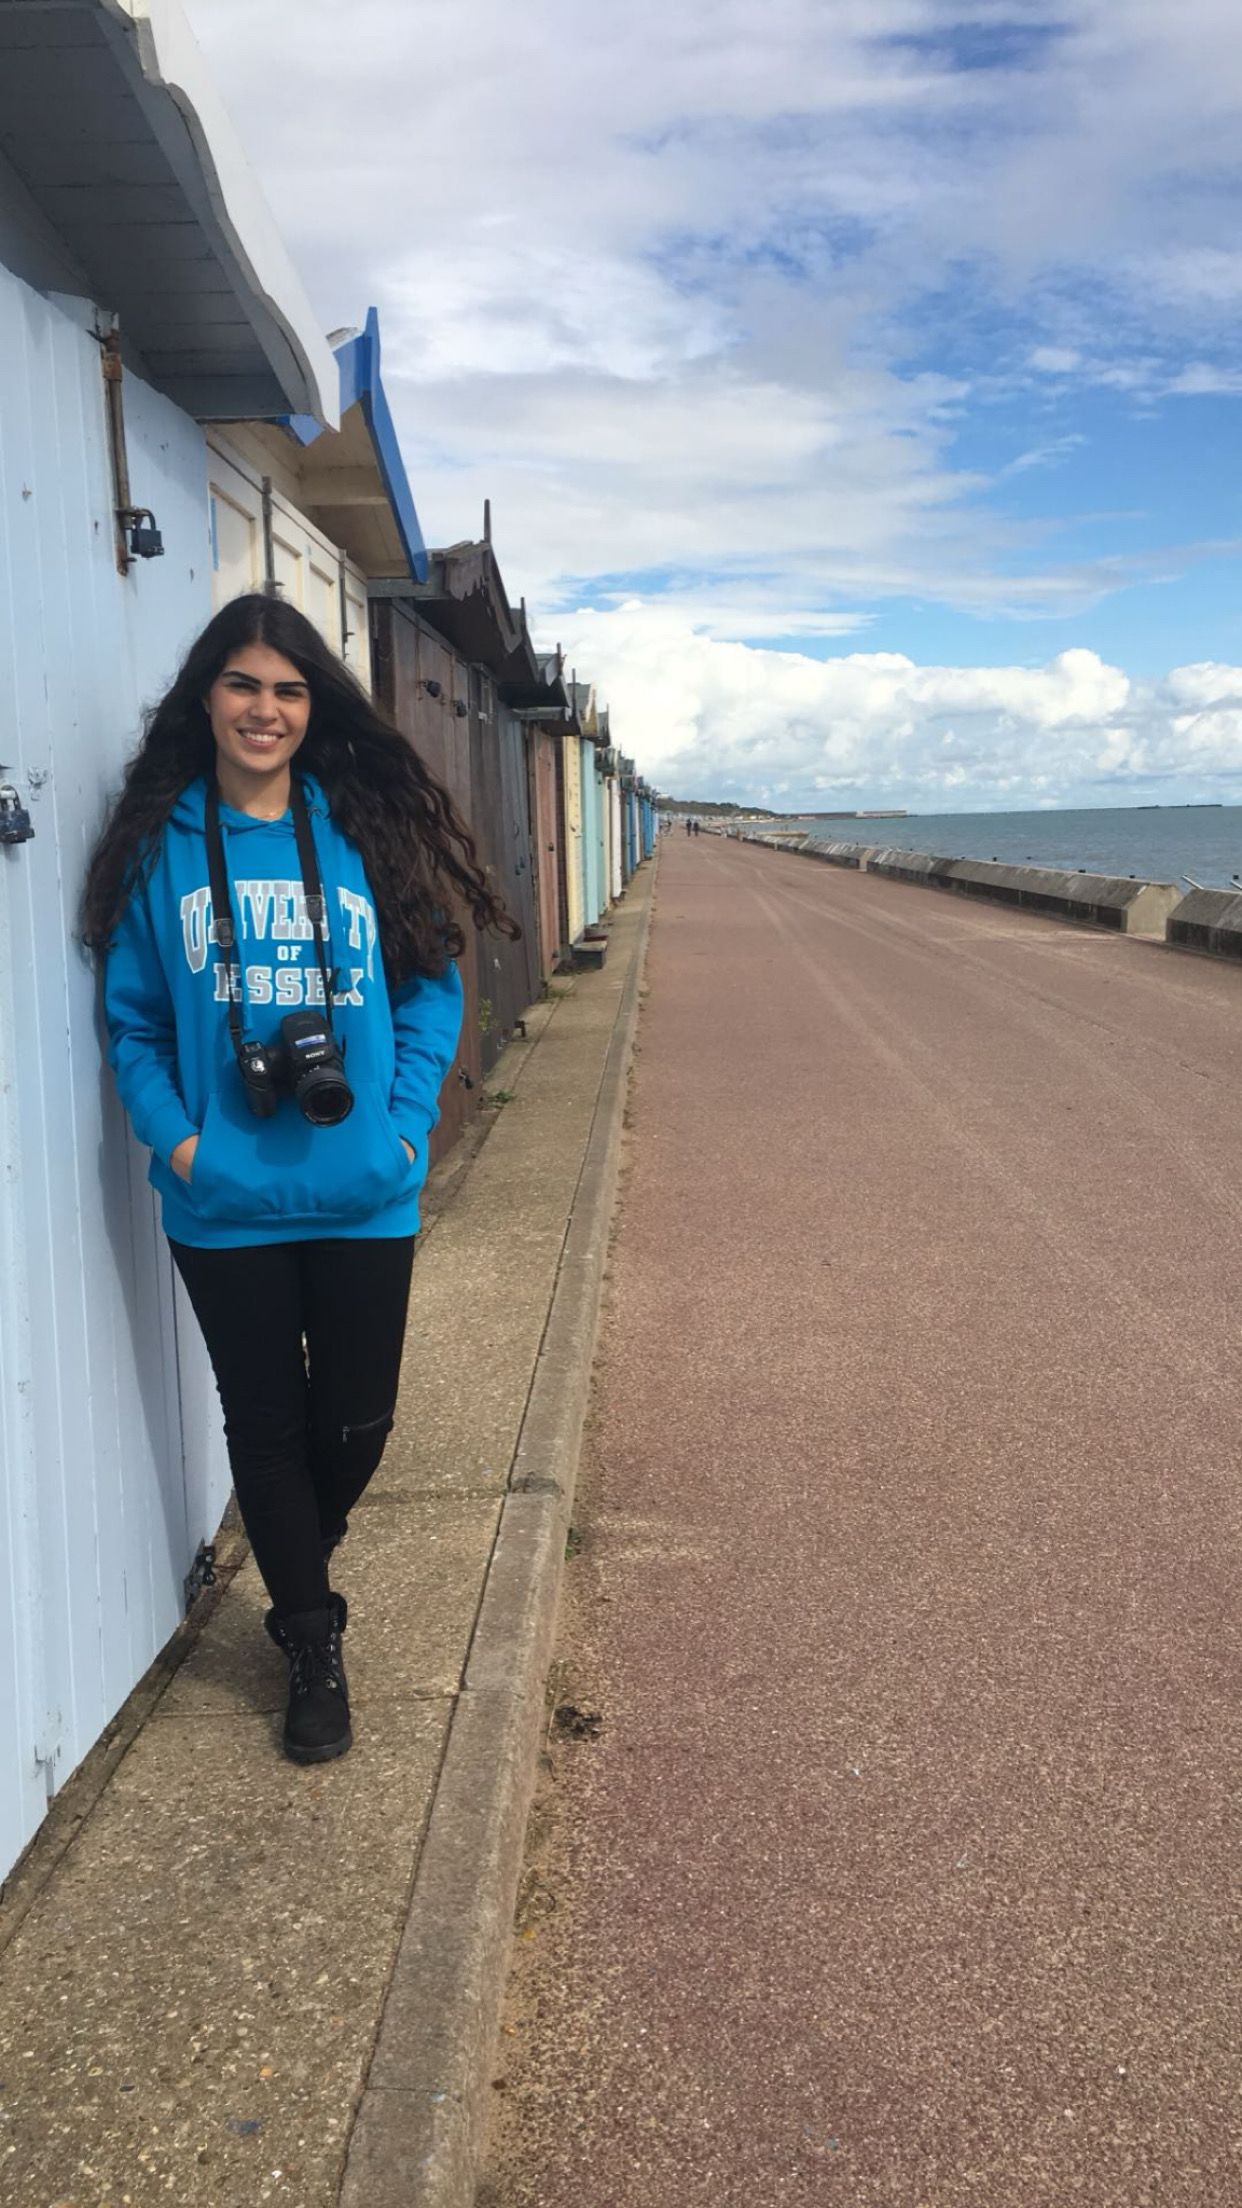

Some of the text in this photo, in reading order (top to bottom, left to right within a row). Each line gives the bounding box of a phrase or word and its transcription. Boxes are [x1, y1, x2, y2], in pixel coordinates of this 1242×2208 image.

[180, 879, 376, 983] UVERTY
[277, 945, 302, 961] OF
[213, 963, 364, 1006] ESSEX
